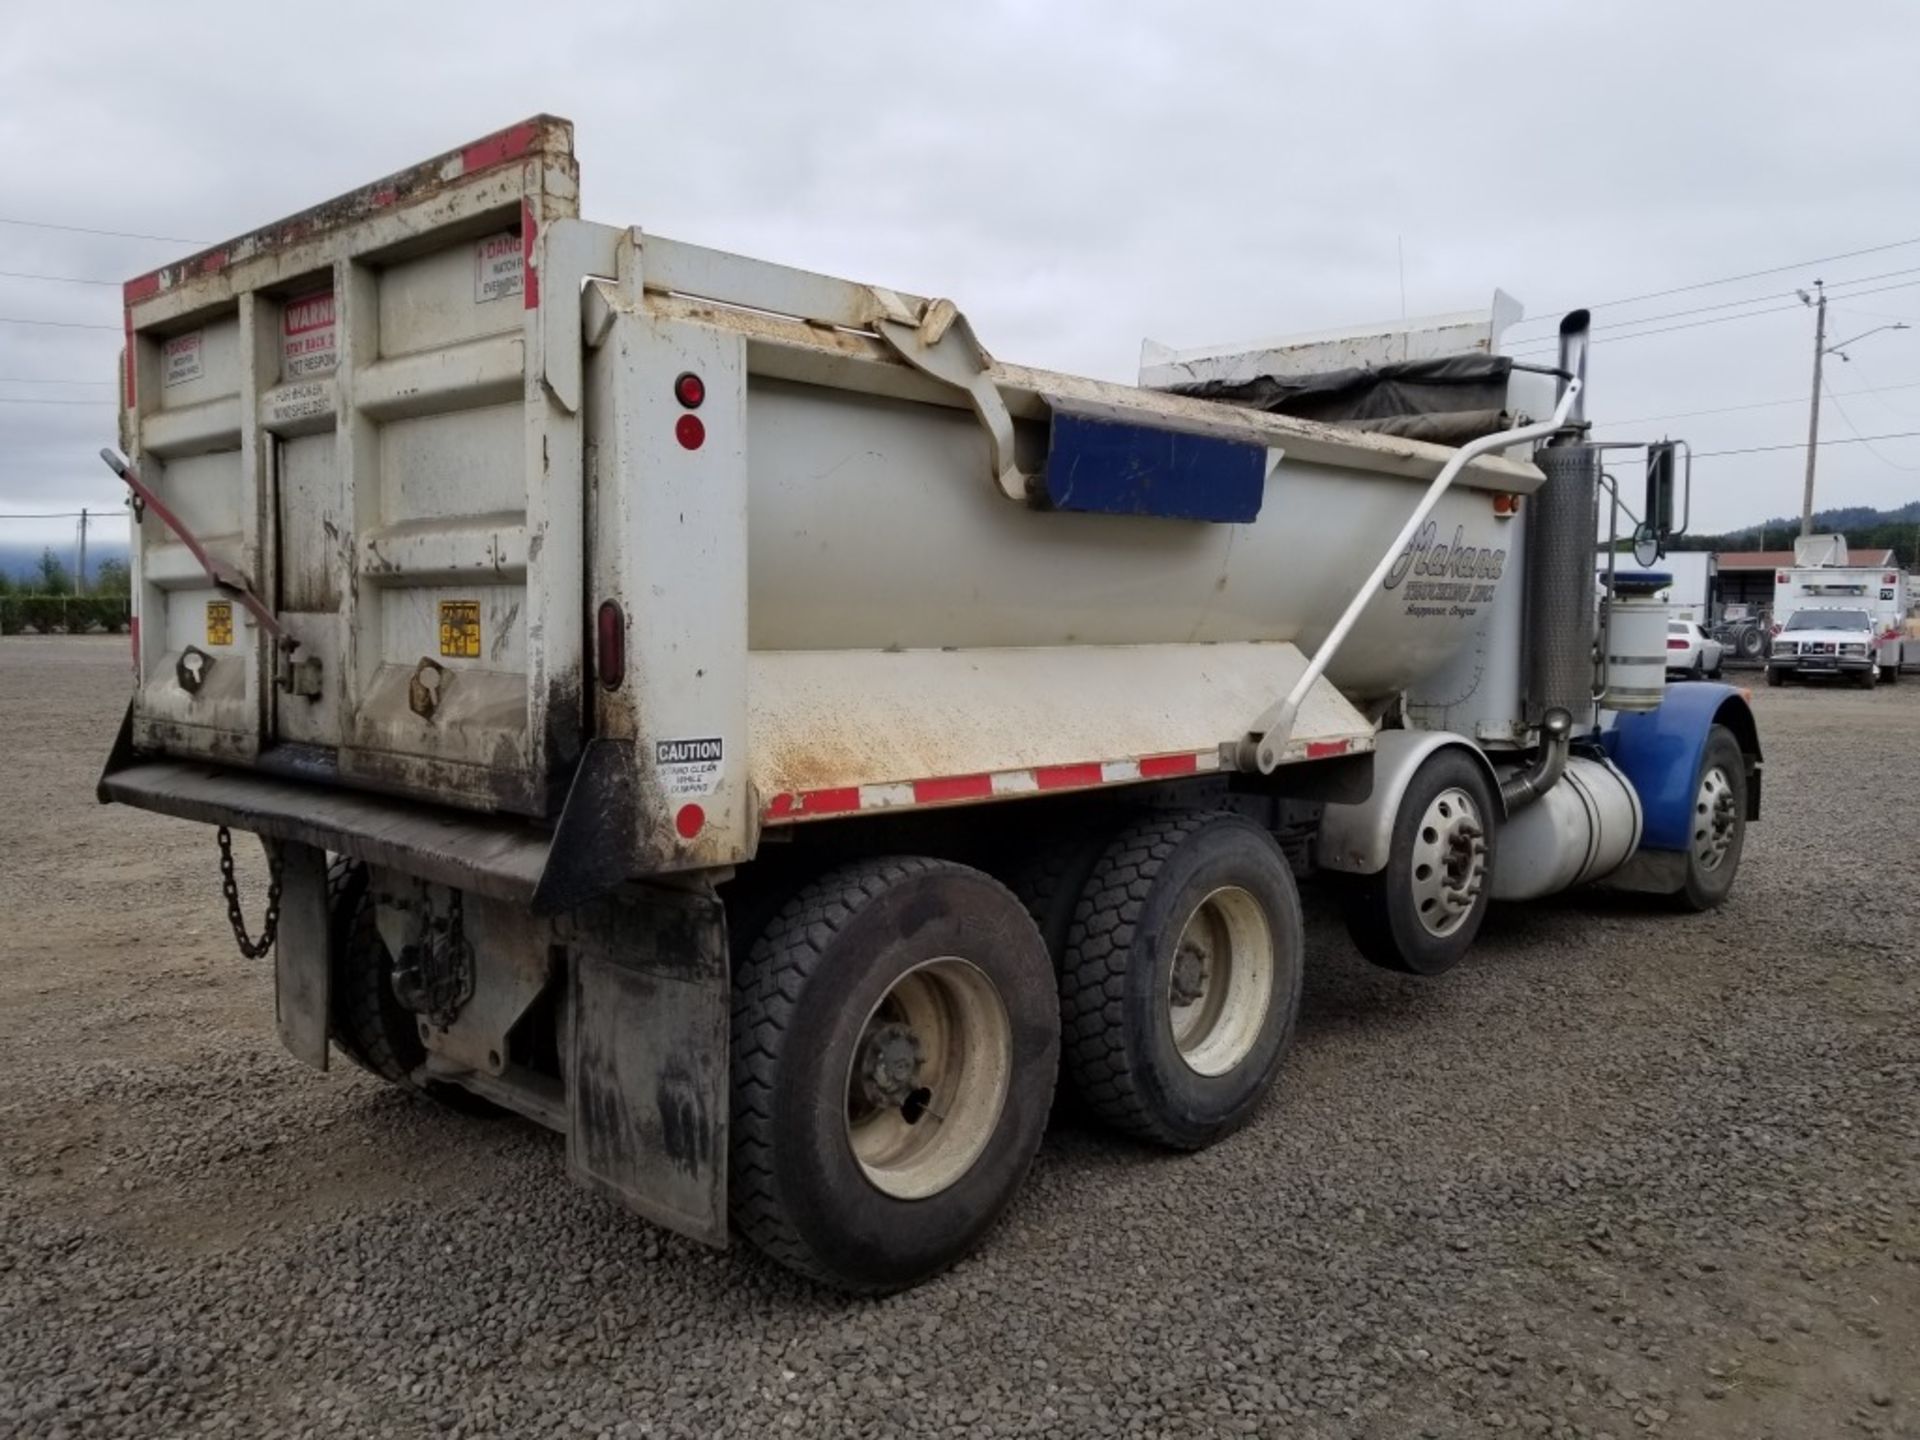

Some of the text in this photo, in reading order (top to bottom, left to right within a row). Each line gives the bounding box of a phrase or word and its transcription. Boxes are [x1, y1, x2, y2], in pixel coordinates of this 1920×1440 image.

[286, 342, 303, 357] STAY
[305, 336, 327, 352] BACK
[288, 359, 303, 378] NOT
[292, 384, 323, 399] BROKEN
[1402, 581, 1470, 603] TRUCKING
[659, 742, 720, 760] CAUTION
[661, 763, 717, 777] SAND CLEAR
[677, 775, 702, 785] WHILE
